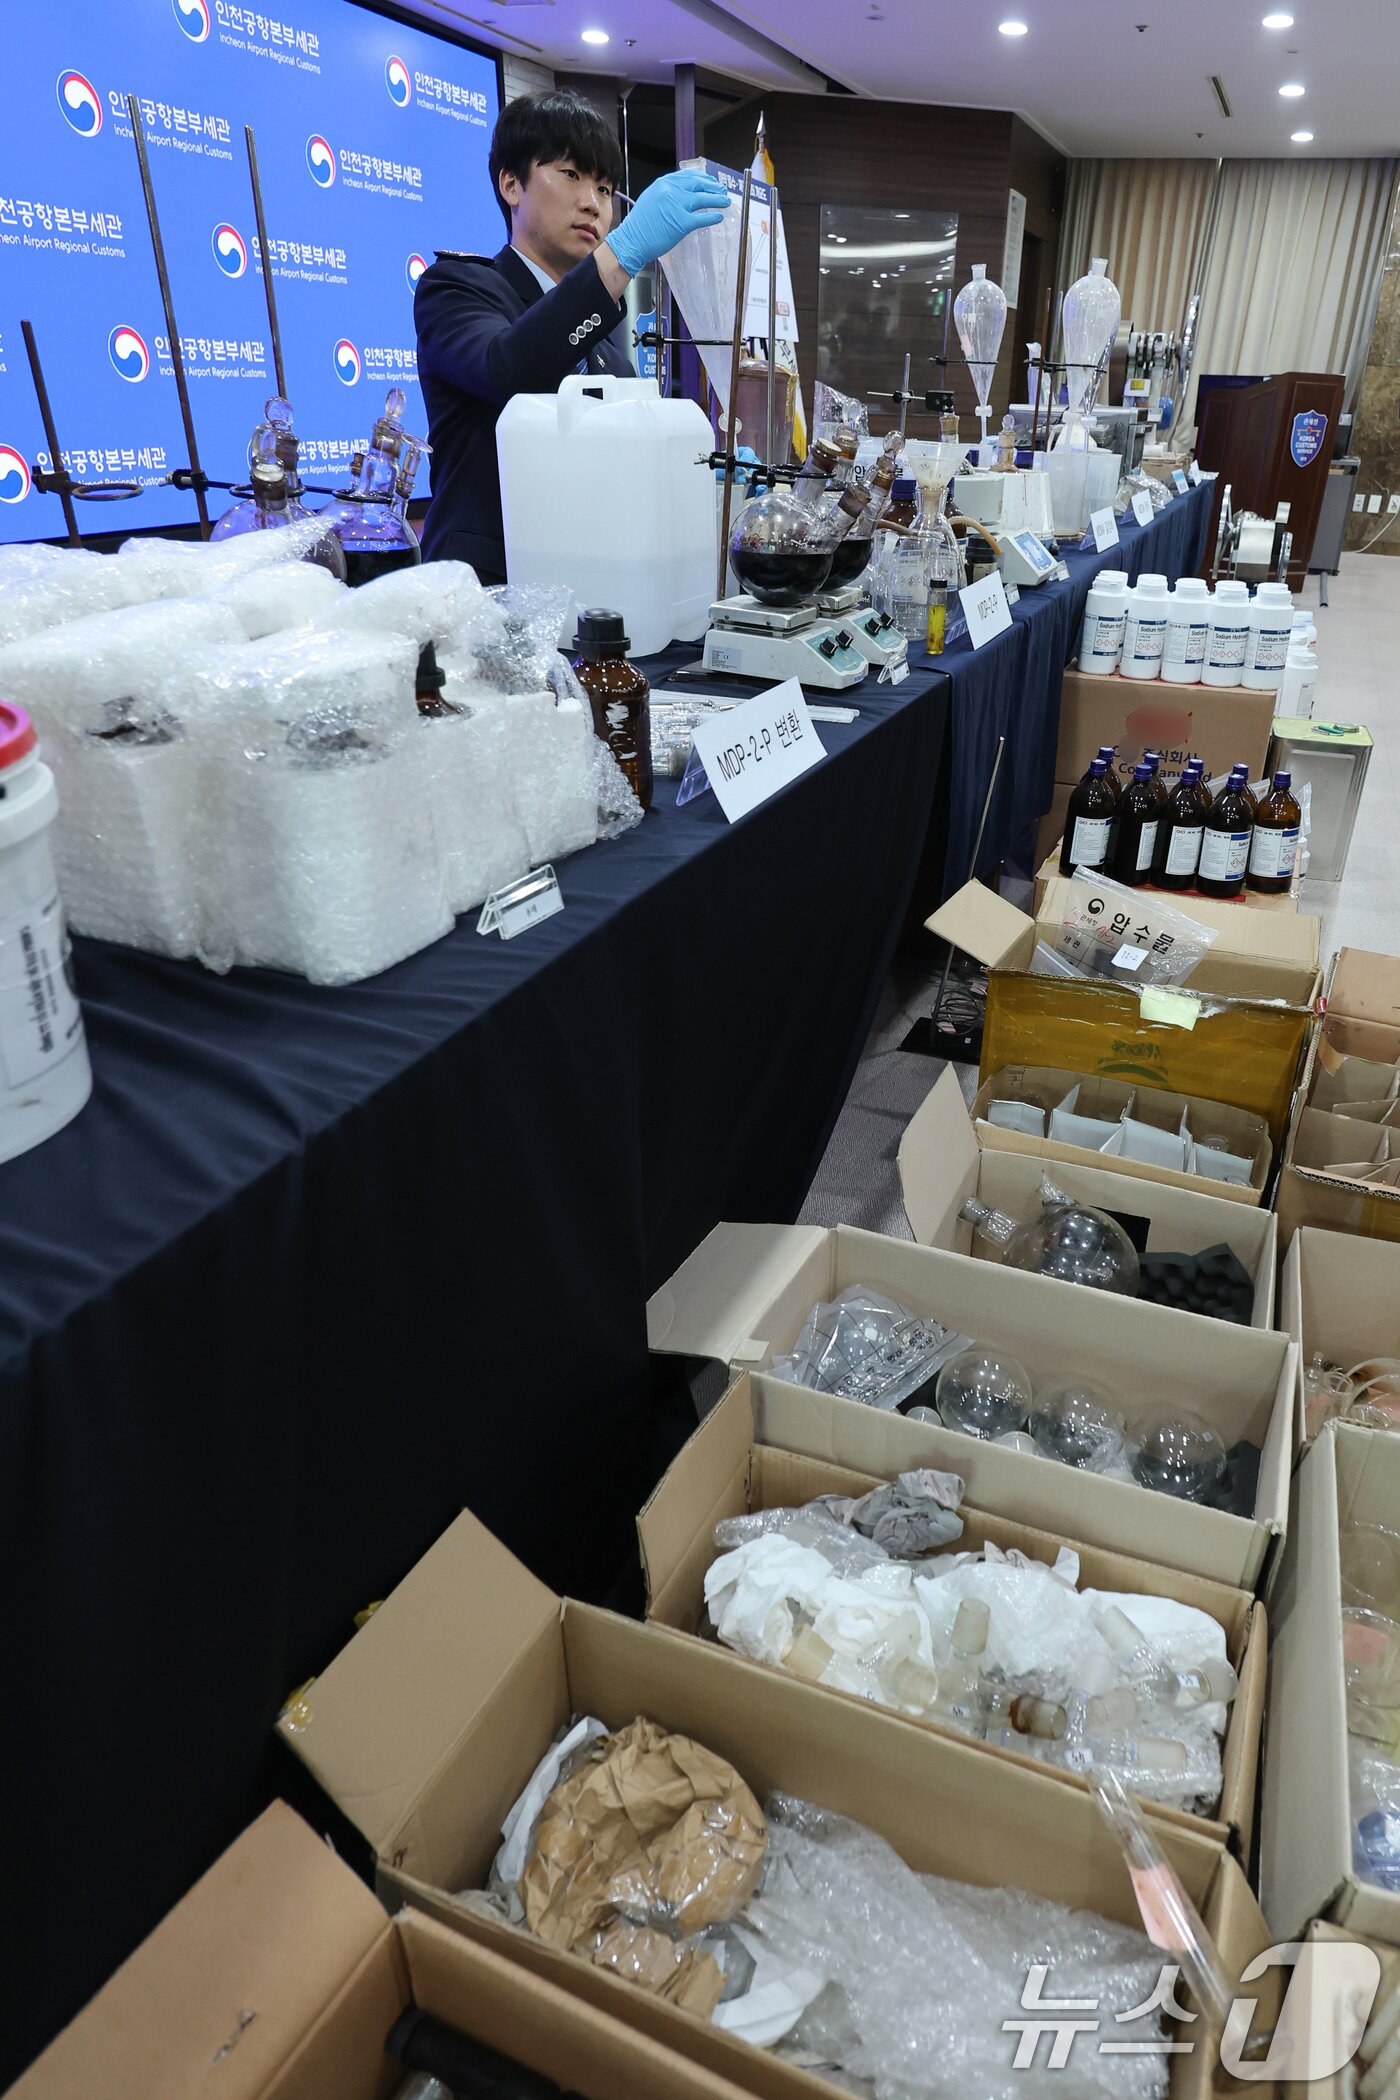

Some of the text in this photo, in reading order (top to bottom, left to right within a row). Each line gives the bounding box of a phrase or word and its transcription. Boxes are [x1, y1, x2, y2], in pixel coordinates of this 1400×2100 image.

[215, 0, 320, 57] 인천공항본부세관
[219, 31, 321, 74] Incheon Airport Regional Customs
[414, 71, 487, 114] 인천공항본부세관
[108, 90, 231, 143] 인공항본부세관
[146, 131, 172, 147] Airport
[172, 137, 203, 153] Regional
[203, 144, 233, 160] Customs
[339, 149, 422, 188] 인천공항본부세관
[23, 234, 53, 250] Airport
[53, 238, 91, 254] Regional
[91, 243, 126, 258] Customs
[280, 267, 300, 280] Airport
[300, 269, 324, 282] Regional
[324, 272, 348, 285] Customs
[154, 336, 265, 363] 인공항본부세관
[188, 366, 212, 379] Airport
[211, 366, 240, 380] Regional
[240, 367, 267, 378] Customs
[716, 709, 803, 782] MDP-2-P 변환
